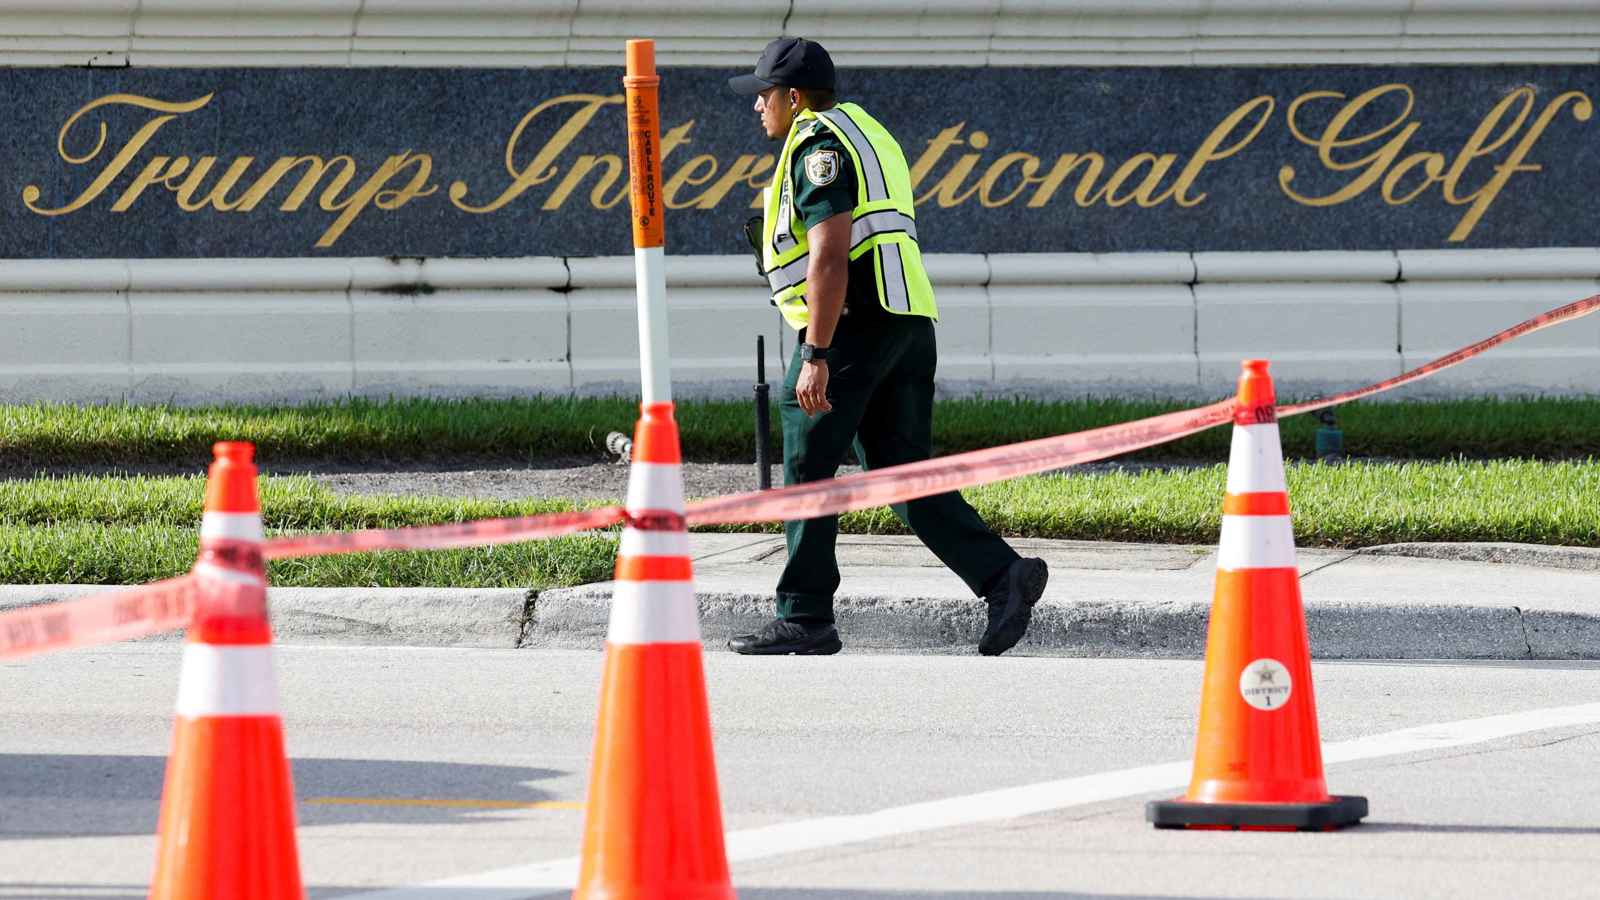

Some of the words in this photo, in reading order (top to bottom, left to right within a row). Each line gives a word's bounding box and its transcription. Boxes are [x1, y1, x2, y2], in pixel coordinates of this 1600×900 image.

[22, 92, 438, 248] Trump
[450, 93, 1275, 212] Intertional
[1279, 83, 1592, 242] Golf
[644, 130, 653, 173] CABLE
[647, 174, 657, 217] ROUTE
[1264, 695, 1272, 706] 1
